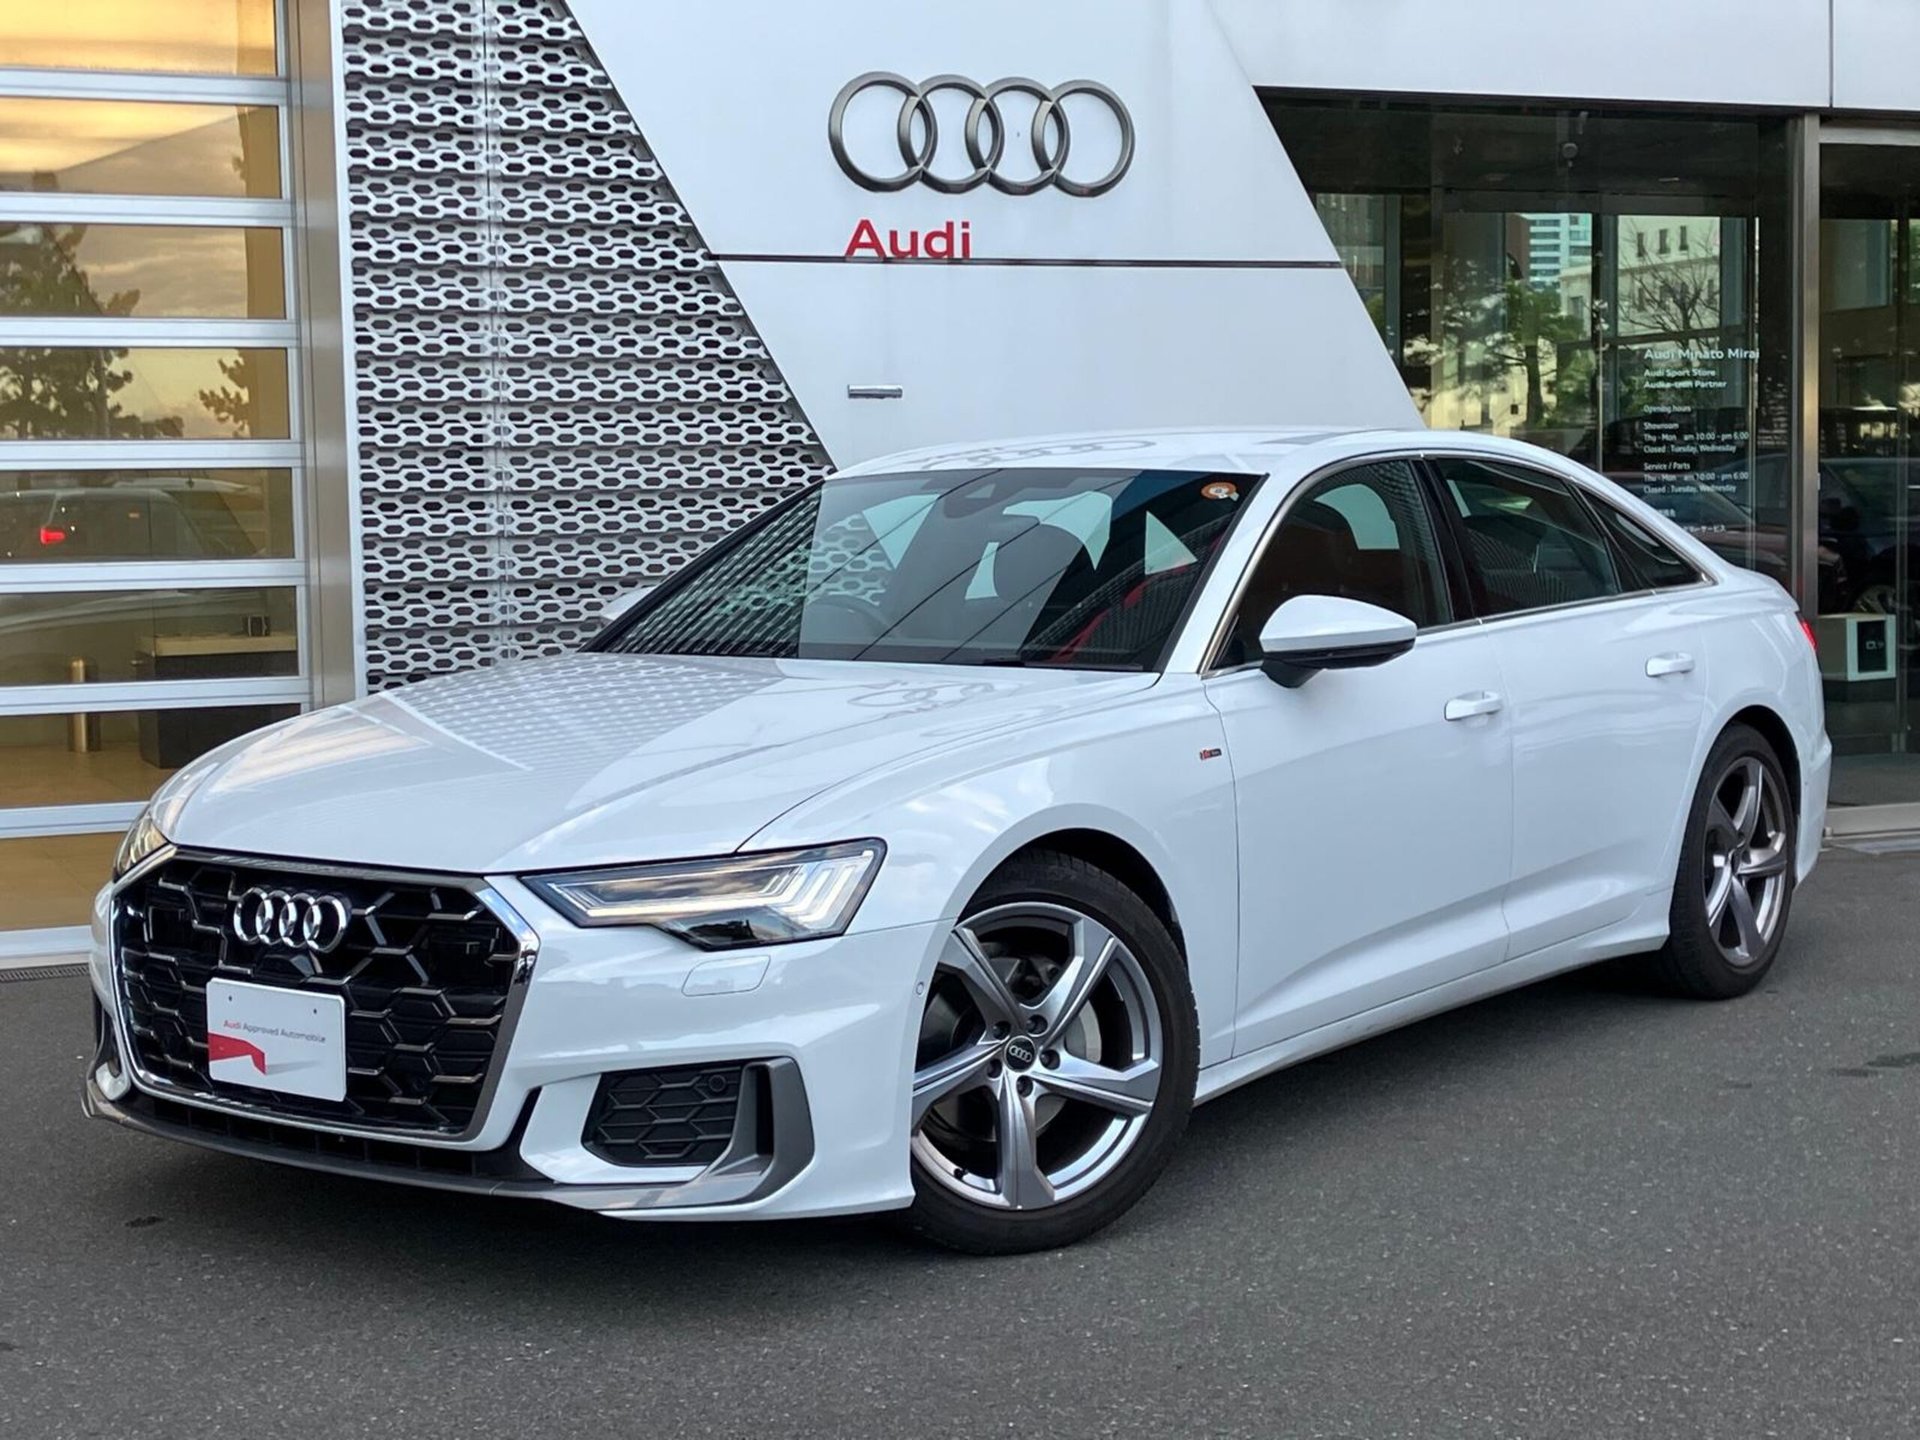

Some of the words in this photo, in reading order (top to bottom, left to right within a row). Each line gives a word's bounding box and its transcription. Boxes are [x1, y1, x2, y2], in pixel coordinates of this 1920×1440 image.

[844, 219, 970, 259] Audi
[1643, 349, 1674, 360] Audi
[1679, 349, 1724, 360] Minato
[1728, 348, 1760, 360] Mirai
[1643, 368, 1664, 377] Audi
[1666, 368, 1690, 378] Sport
[1692, 368, 1716, 377] Store
[1694, 380, 1727, 388] Partner
[1643, 405, 1671, 414] Opening
[1643, 422, 1680, 430] Showroom
[1643, 445, 1666, 453] Closed
[1699, 445, 1737, 453] Wednesday
[1643, 462, 1667, 470] Service
[1673, 461, 1691, 470] Parts
[1643, 485, 1666, 493] Closed
[1699, 485, 1737, 493] Wednesday
[223, 1020, 241, 1029] Audi
[243, 1022, 280, 1036] Approved
[280, 1028, 326, 1043] Automobile
